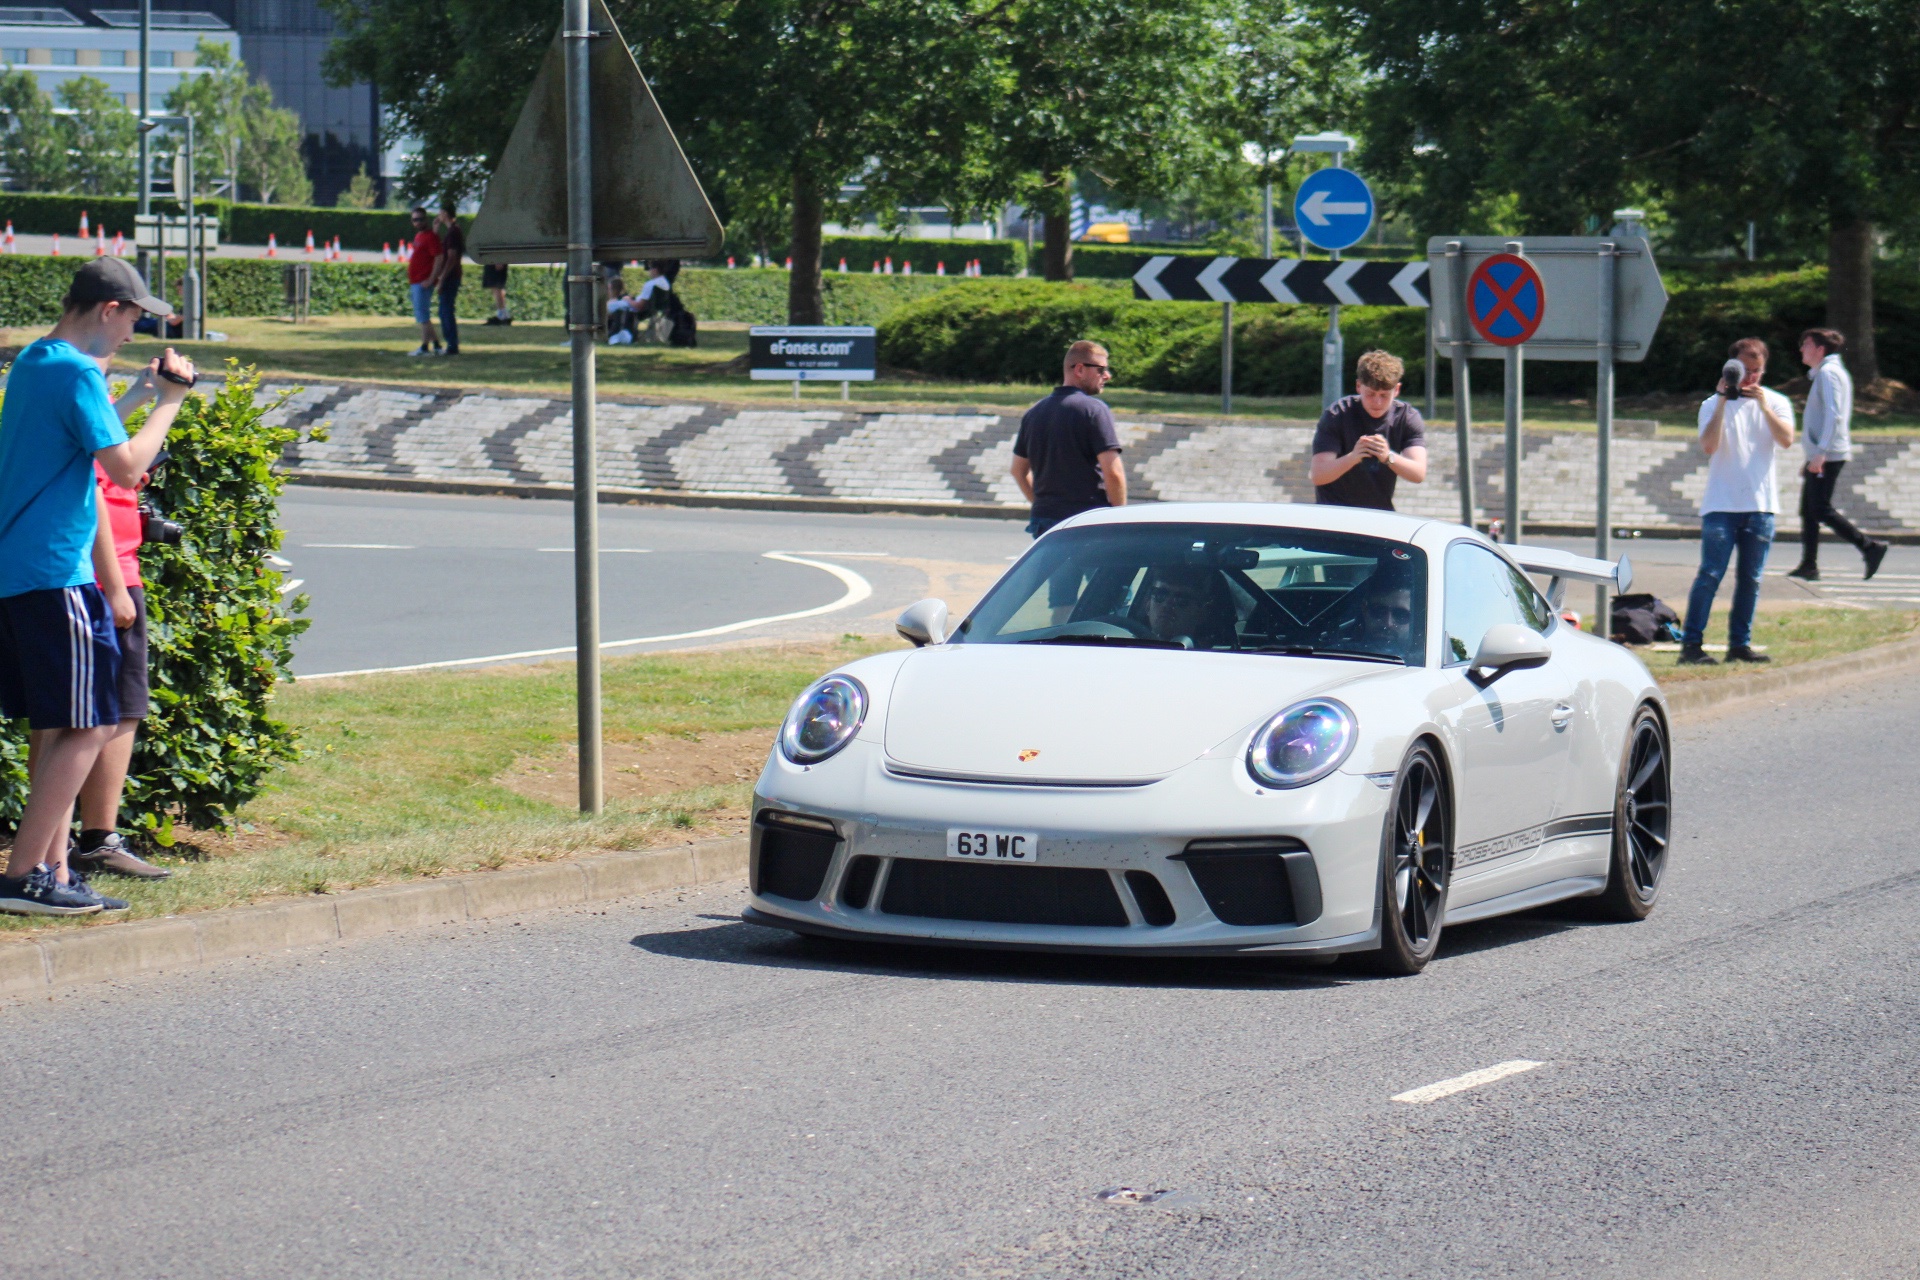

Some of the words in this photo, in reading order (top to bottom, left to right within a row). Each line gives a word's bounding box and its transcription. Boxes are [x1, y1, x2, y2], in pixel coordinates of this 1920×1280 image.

[769, 339, 850, 356] eFones.com
[957, 832, 988, 856] 63
[995, 834, 1026, 858] WC
